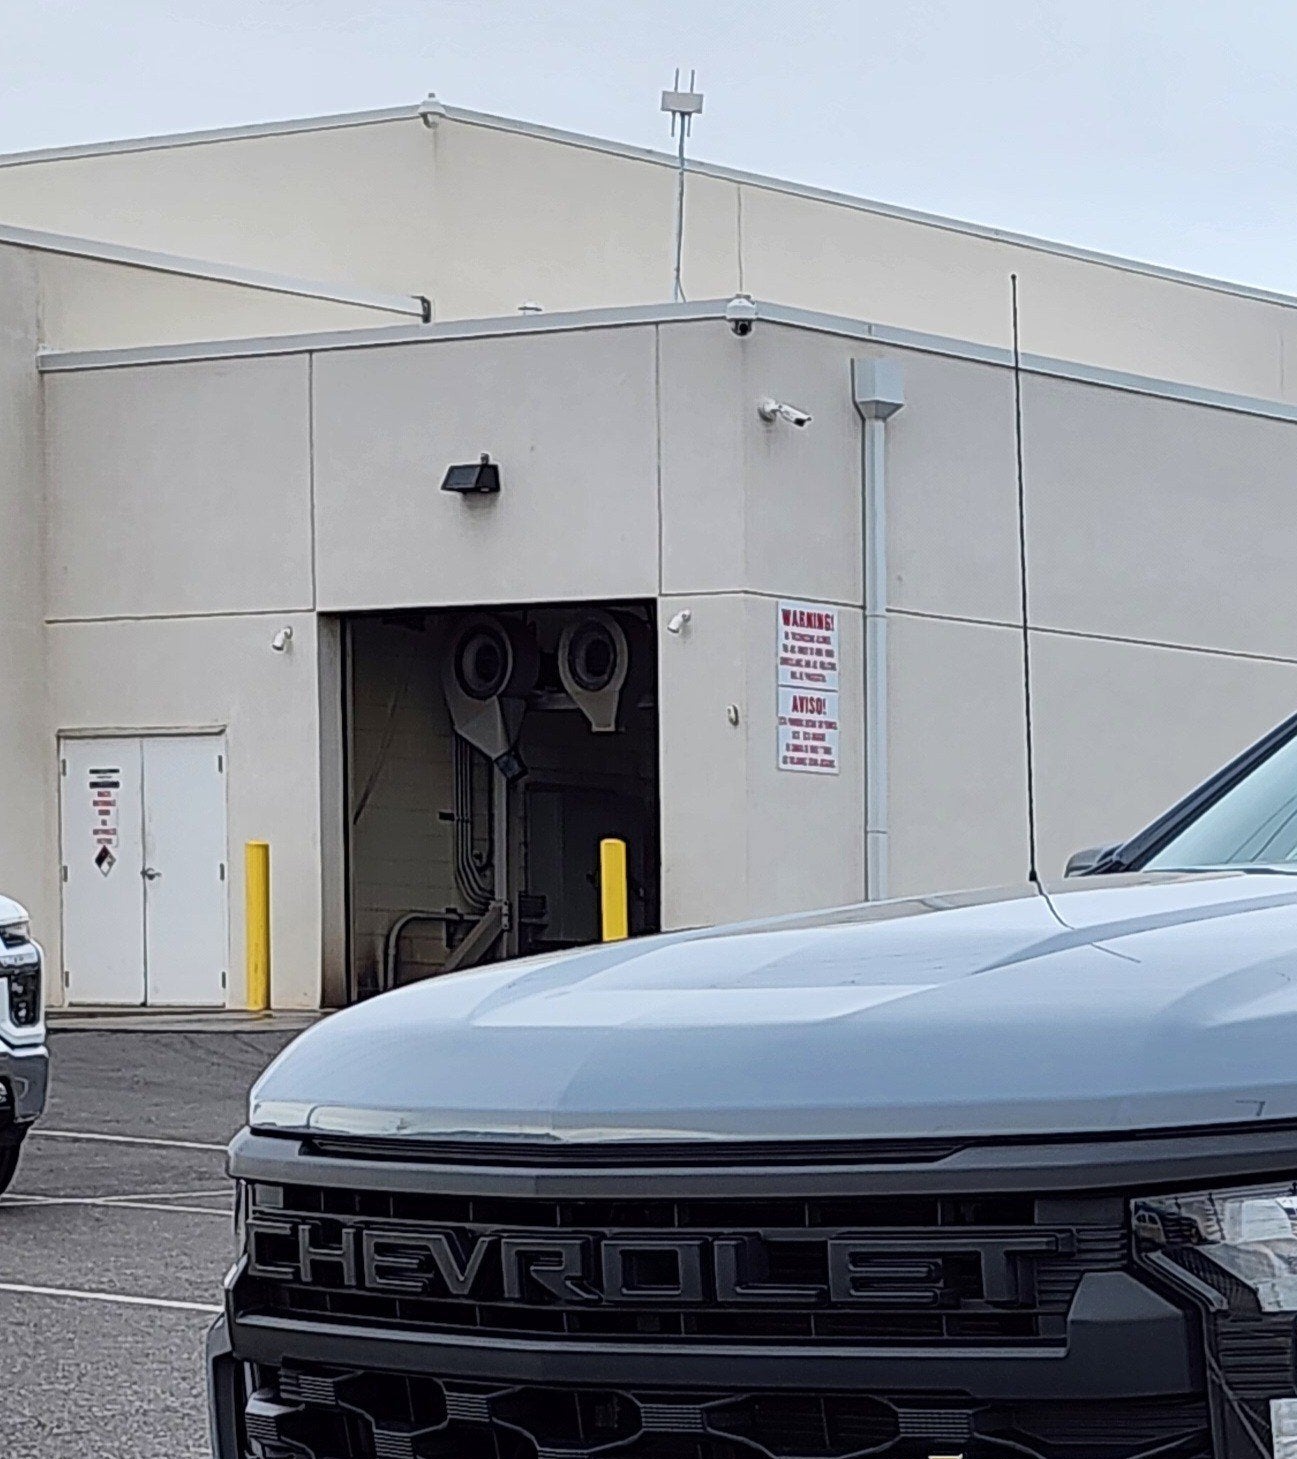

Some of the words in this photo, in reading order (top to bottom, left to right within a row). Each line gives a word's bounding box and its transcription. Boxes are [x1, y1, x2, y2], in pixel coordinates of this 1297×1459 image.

[781, 608, 835, 632] WARNING!
[791, 694, 827, 716] AVISO!
[246, 1216, 1072, 1307] CHEVROLET
